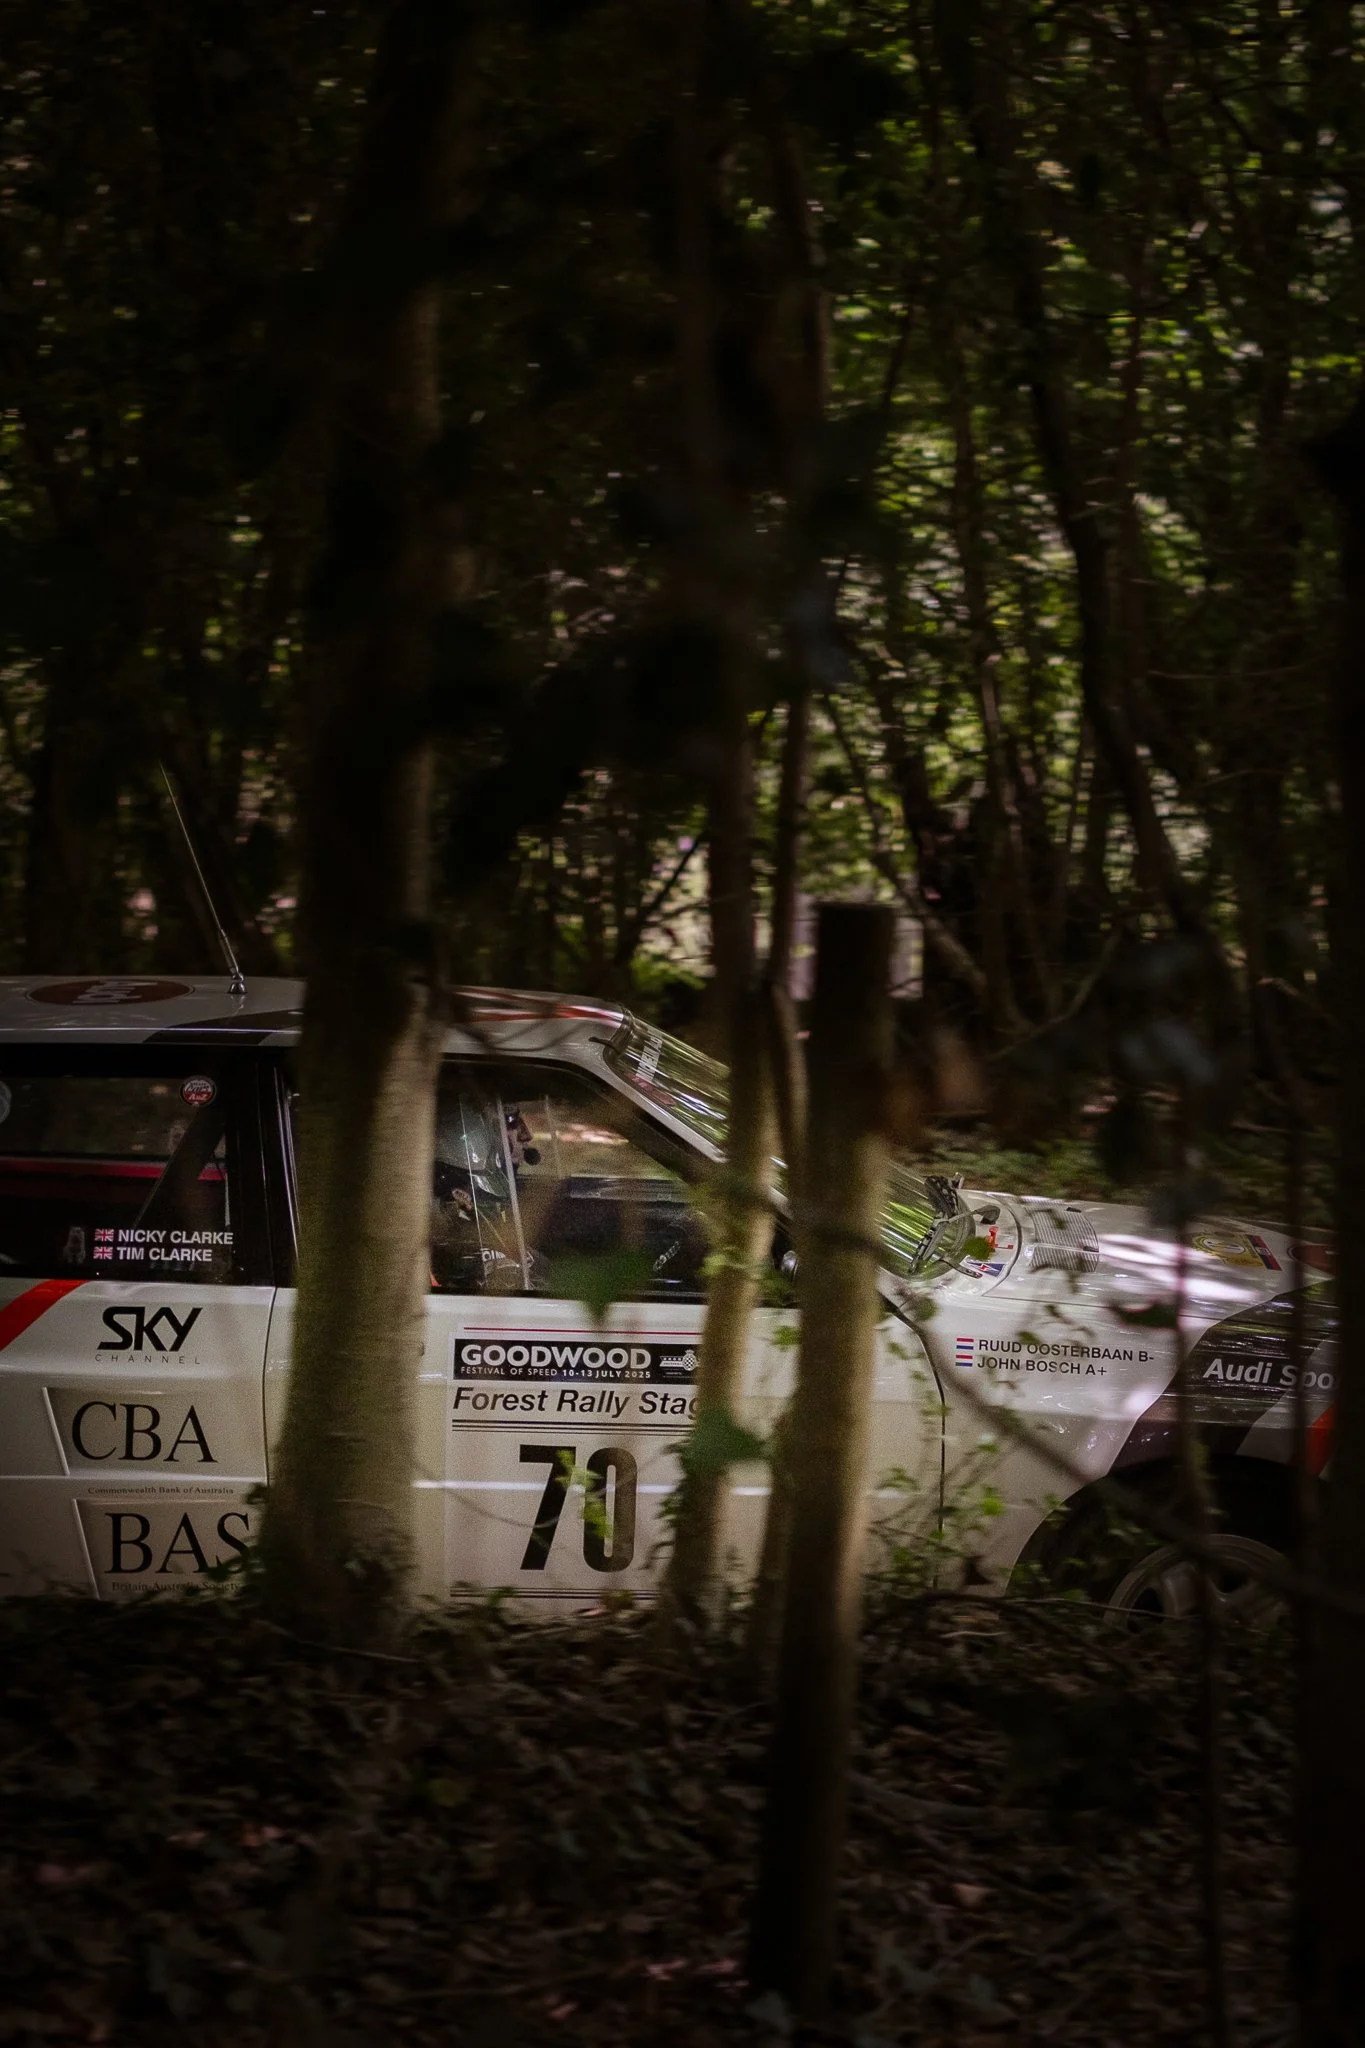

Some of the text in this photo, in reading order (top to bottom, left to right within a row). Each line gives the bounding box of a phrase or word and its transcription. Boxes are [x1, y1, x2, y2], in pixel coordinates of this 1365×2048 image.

[117, 1228, 234, 1245] NICKY CLARKE
[116, 1246, 213, 1262] TIM CLARKE
[97, 1306, 203, 1352] SKY
[95, 1353, 201, 1365] CHANNEL
[460, 1344, 652, 1370] GOODWOOD
[978, 1339, 1022, 1354] RUUD
[1026, 1342, 1133, 1362] OOSTERBAAN
[460, 1366, 652, 1380] FESTIVAL OF SPEED 10-13 JULY 2025
[977, 1356, 1021, 1371] JOHN
[1025, 1359, 1081, 1375] BOSCH
[1202, 1357, 1337, 1390] Audi Spo
[453, 1387, 700, 1421] Forest Rally Stag
[71, 1401, 218, 1463] CBA
[87, 1486, 234, 1495] Commonwealth Bank of Australia
[518, 1444, 638, 1573] 70
[104, 1512, 250, 1574] BAS
